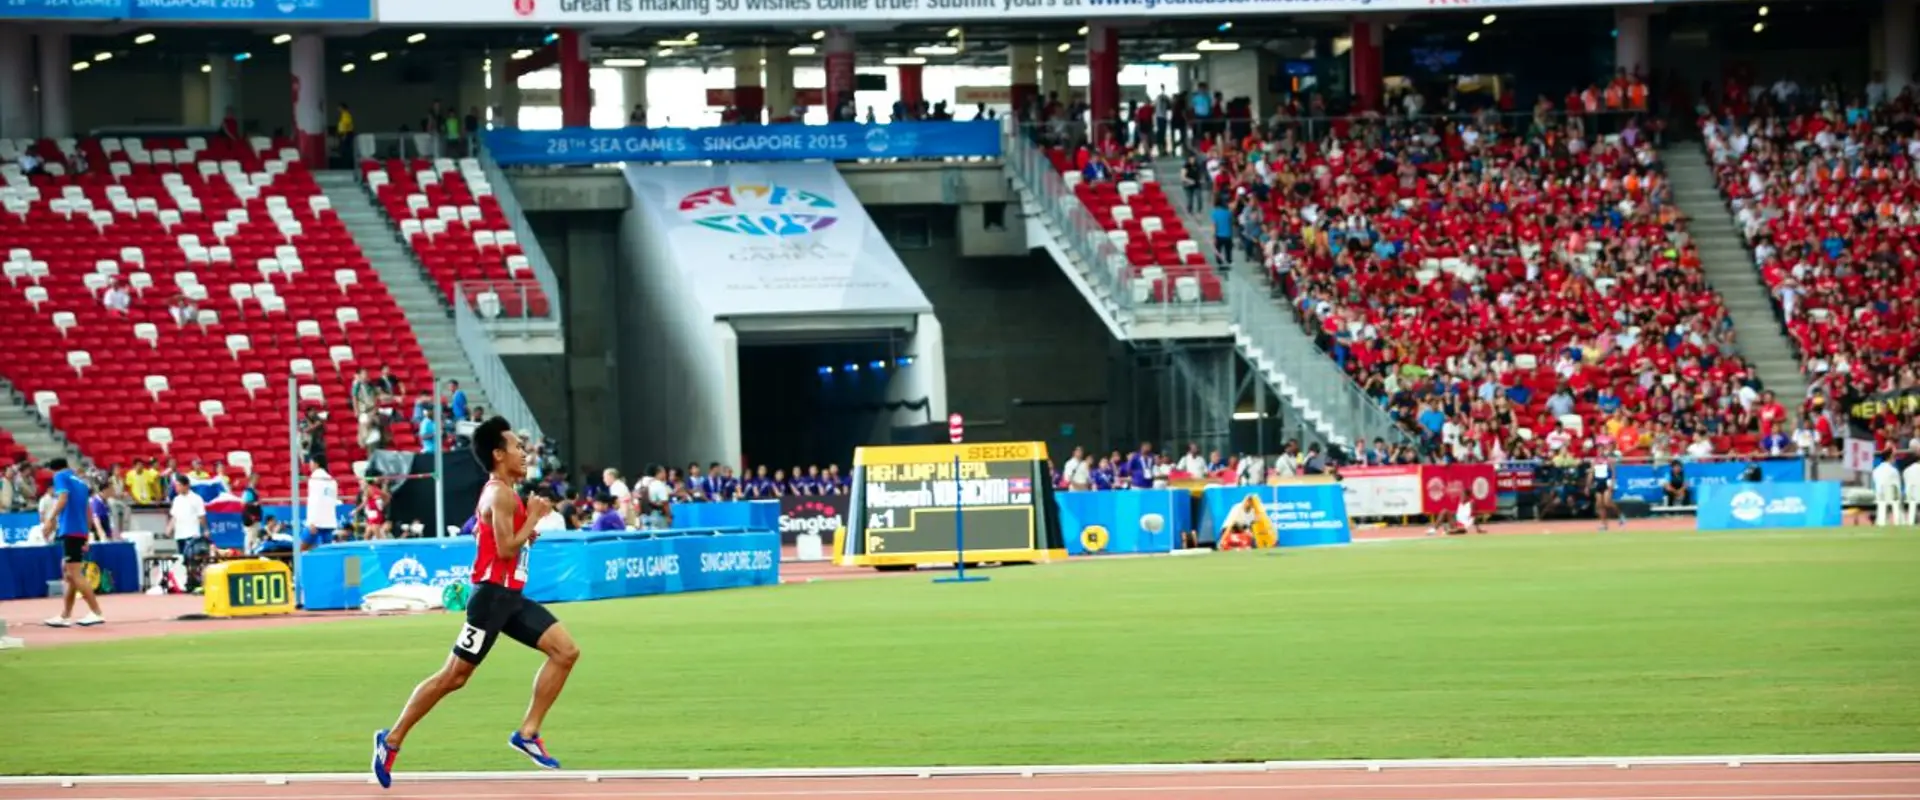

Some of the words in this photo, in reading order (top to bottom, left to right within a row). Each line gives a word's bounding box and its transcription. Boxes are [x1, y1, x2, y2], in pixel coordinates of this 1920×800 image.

[560, 0, 610, 12] Great
[618, 0, 633, 13] is
[639, 0, 711, 15] making
[745, 0, 812, 10] wishes
[818, 0, 868, 10] come
[589, 137, 621, 153] SEA
[625, 136, 686, 152] GAMES
[703, 135, 801, 151] SINGAPORE
[808, 134, 847, 150] 2015
[967, 445, 1030, 460] SEIKO
[778, 514, 842, 535] Singtel
[626, 557, 646, 579] SEA
[646, 554, 680, 577] GAMES
[700, 550, 751, 573] SINGAPORE
[752, 549, 773, 571] 2015
[238, 574, 285, 605] 1:00
[462, 628, 477, 649] 3
